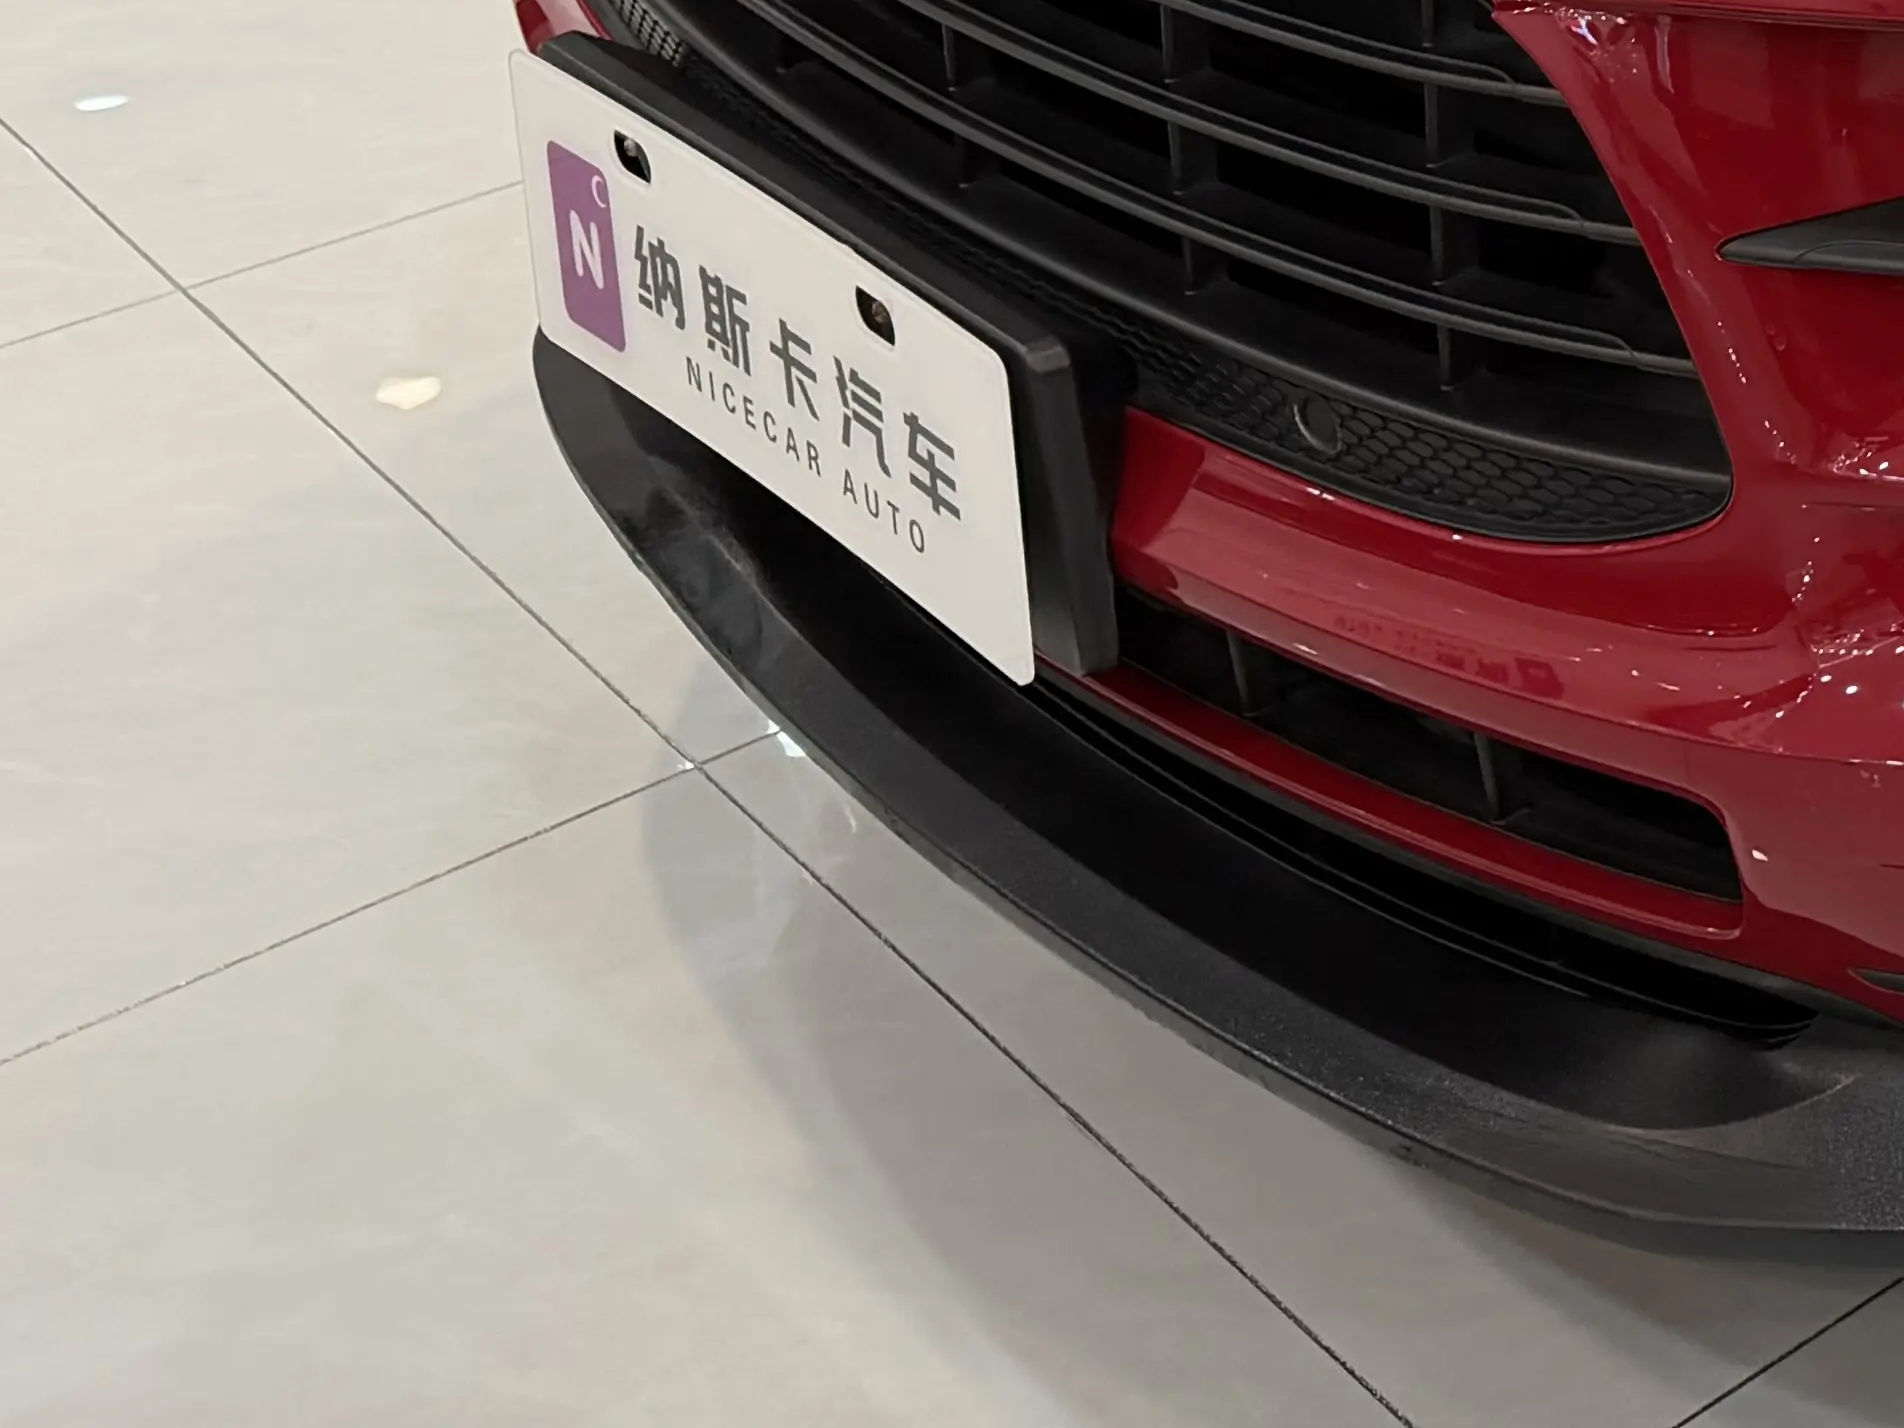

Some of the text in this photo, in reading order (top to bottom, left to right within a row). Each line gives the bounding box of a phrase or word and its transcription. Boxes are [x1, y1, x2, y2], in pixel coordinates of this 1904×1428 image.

[568, 209, 605, 290] N
[633, 224, 963, 521] 纳斯卡汽车
[685, 355, 927, 555] NICECAR AUTO
